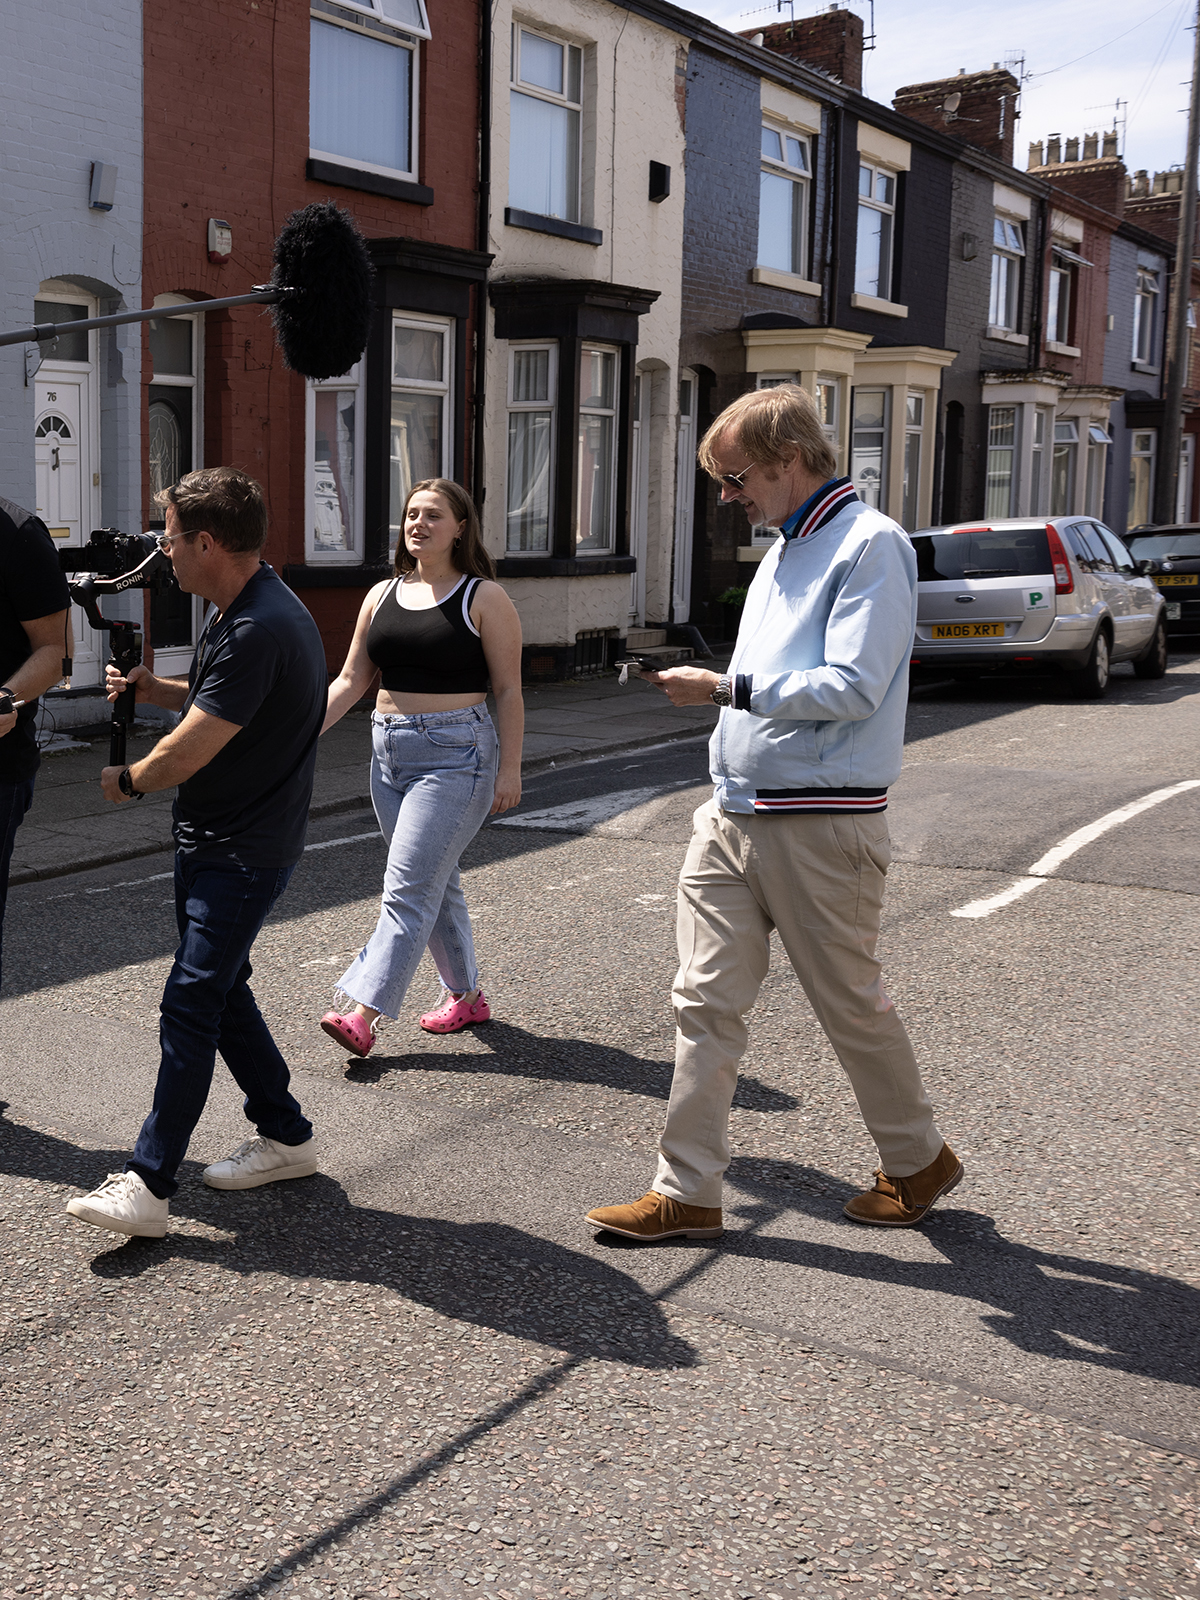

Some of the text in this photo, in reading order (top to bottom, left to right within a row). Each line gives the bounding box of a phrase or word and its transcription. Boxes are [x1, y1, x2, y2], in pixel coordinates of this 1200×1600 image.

[47, 392, 57, 402] 76
[115, 572, 144, 590] RONIN
[1029, 592, 1043, 606] P
[937, 624, 999, 637] NA06 XRT
